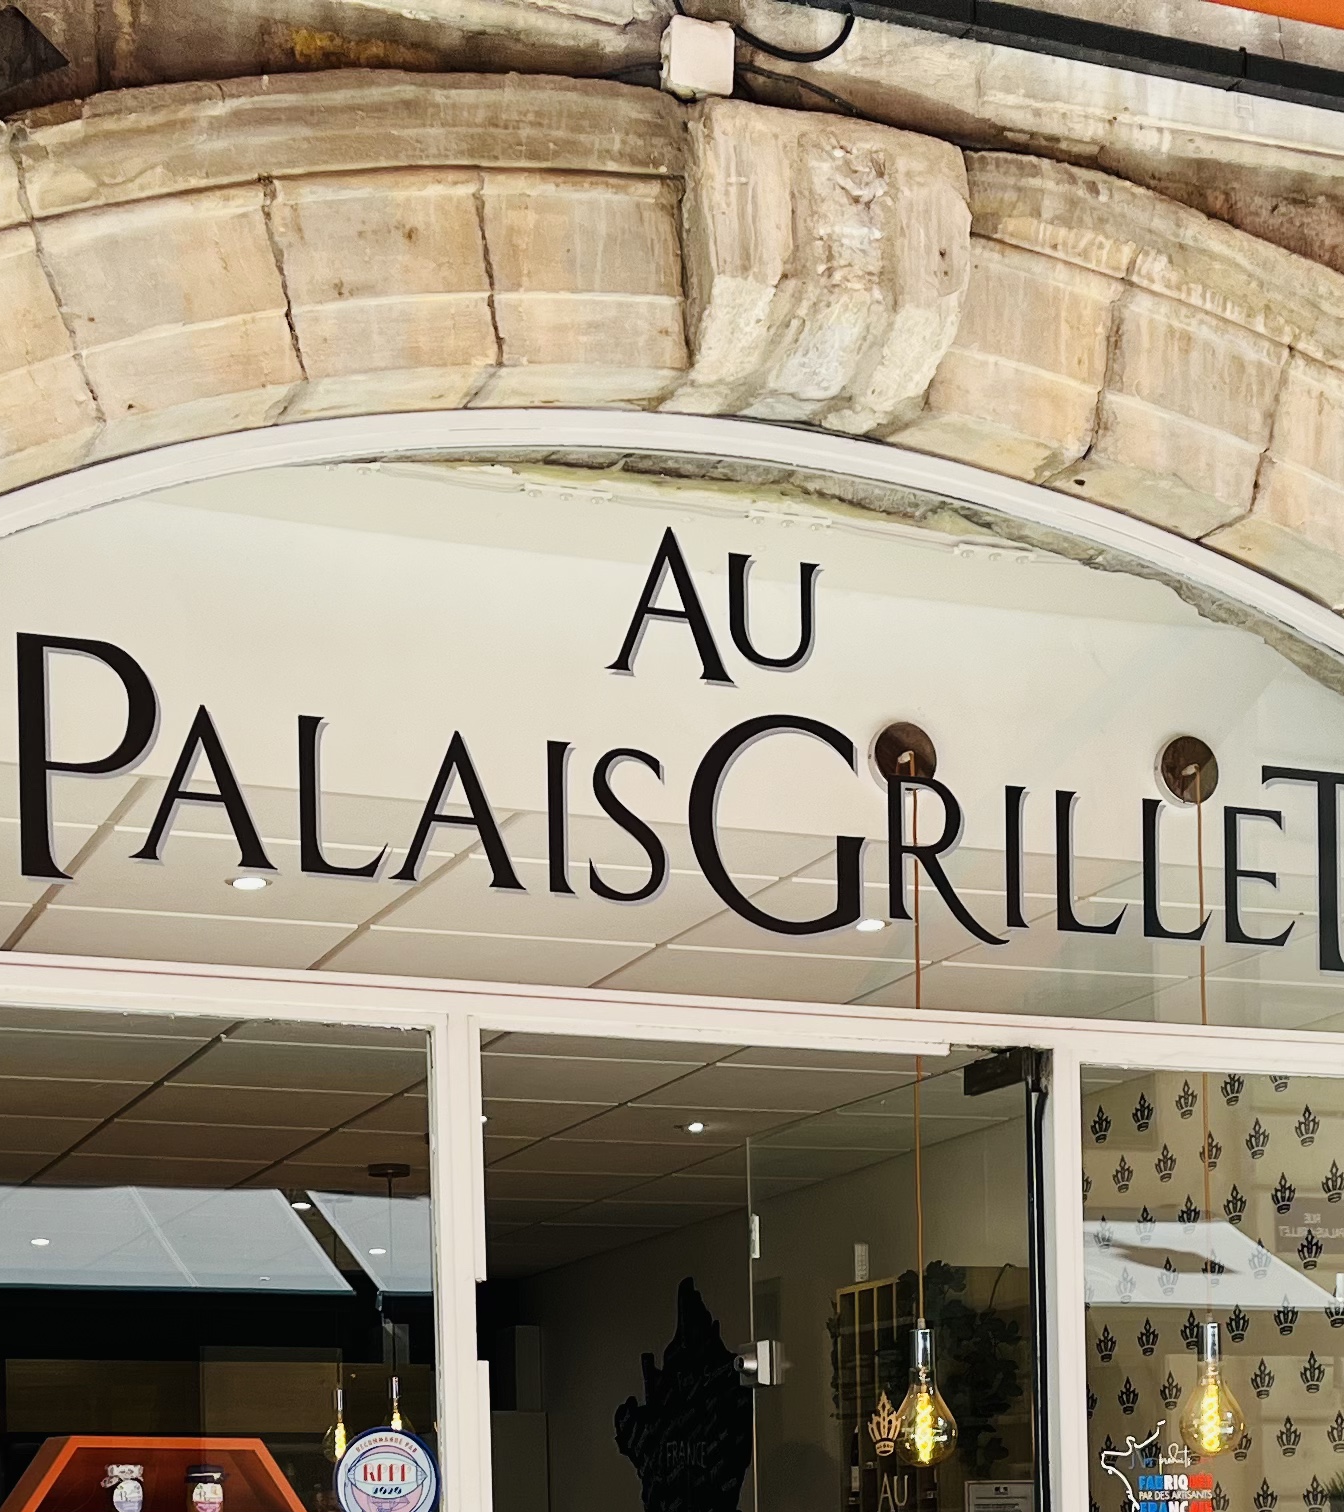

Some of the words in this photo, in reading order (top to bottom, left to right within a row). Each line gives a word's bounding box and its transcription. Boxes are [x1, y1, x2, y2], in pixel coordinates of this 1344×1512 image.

[605, 526, 821, 686] AU
[1138, 1490, 1153, 1500] PAR
[1154, 1490, 1170, 1500] DES
